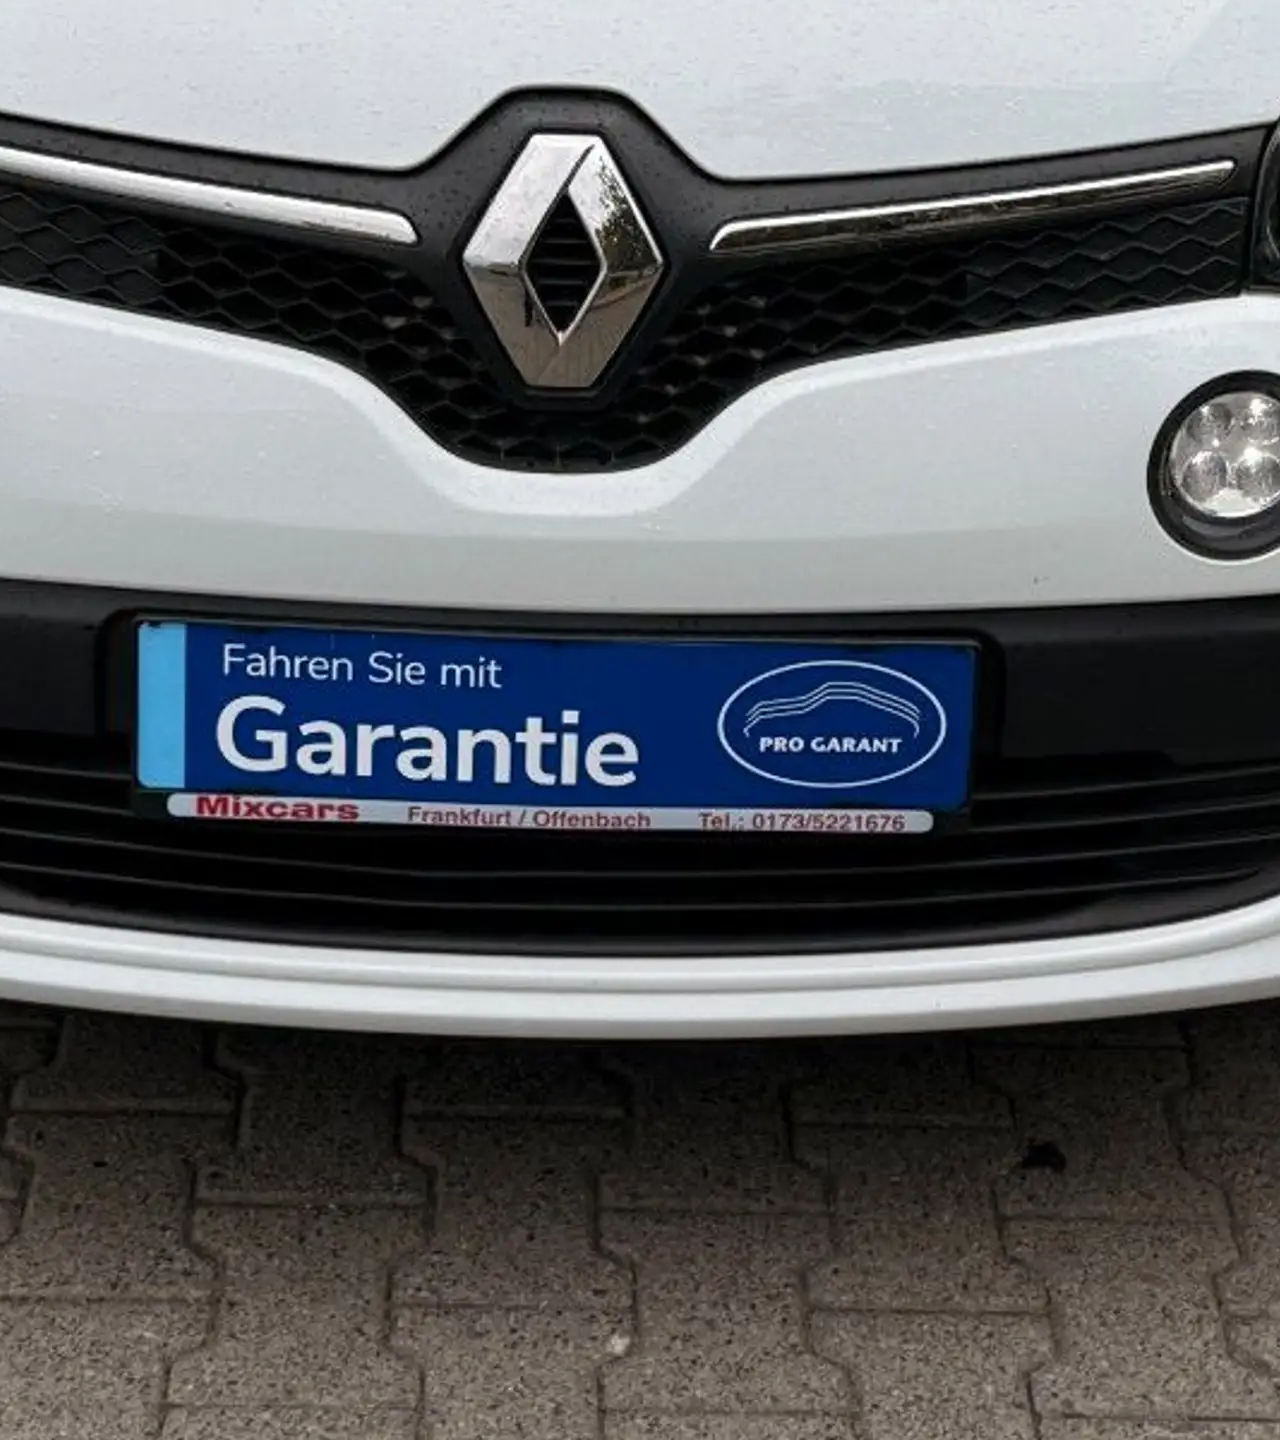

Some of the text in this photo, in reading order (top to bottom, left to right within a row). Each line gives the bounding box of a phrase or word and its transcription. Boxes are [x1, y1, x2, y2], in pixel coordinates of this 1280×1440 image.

[223, 643, 502, 688] Fahren Sie mit
[216, 695, 639, 788] Garantie
[759, 736, 903, 754] PRO GARANT
[195, 794, 360, 821] Mixcars
[407, 805, 512, 828] Frankfurt
[532, 809, 652, 829] Offenbach
[752, 813, 907, 833] 0173/5221676
